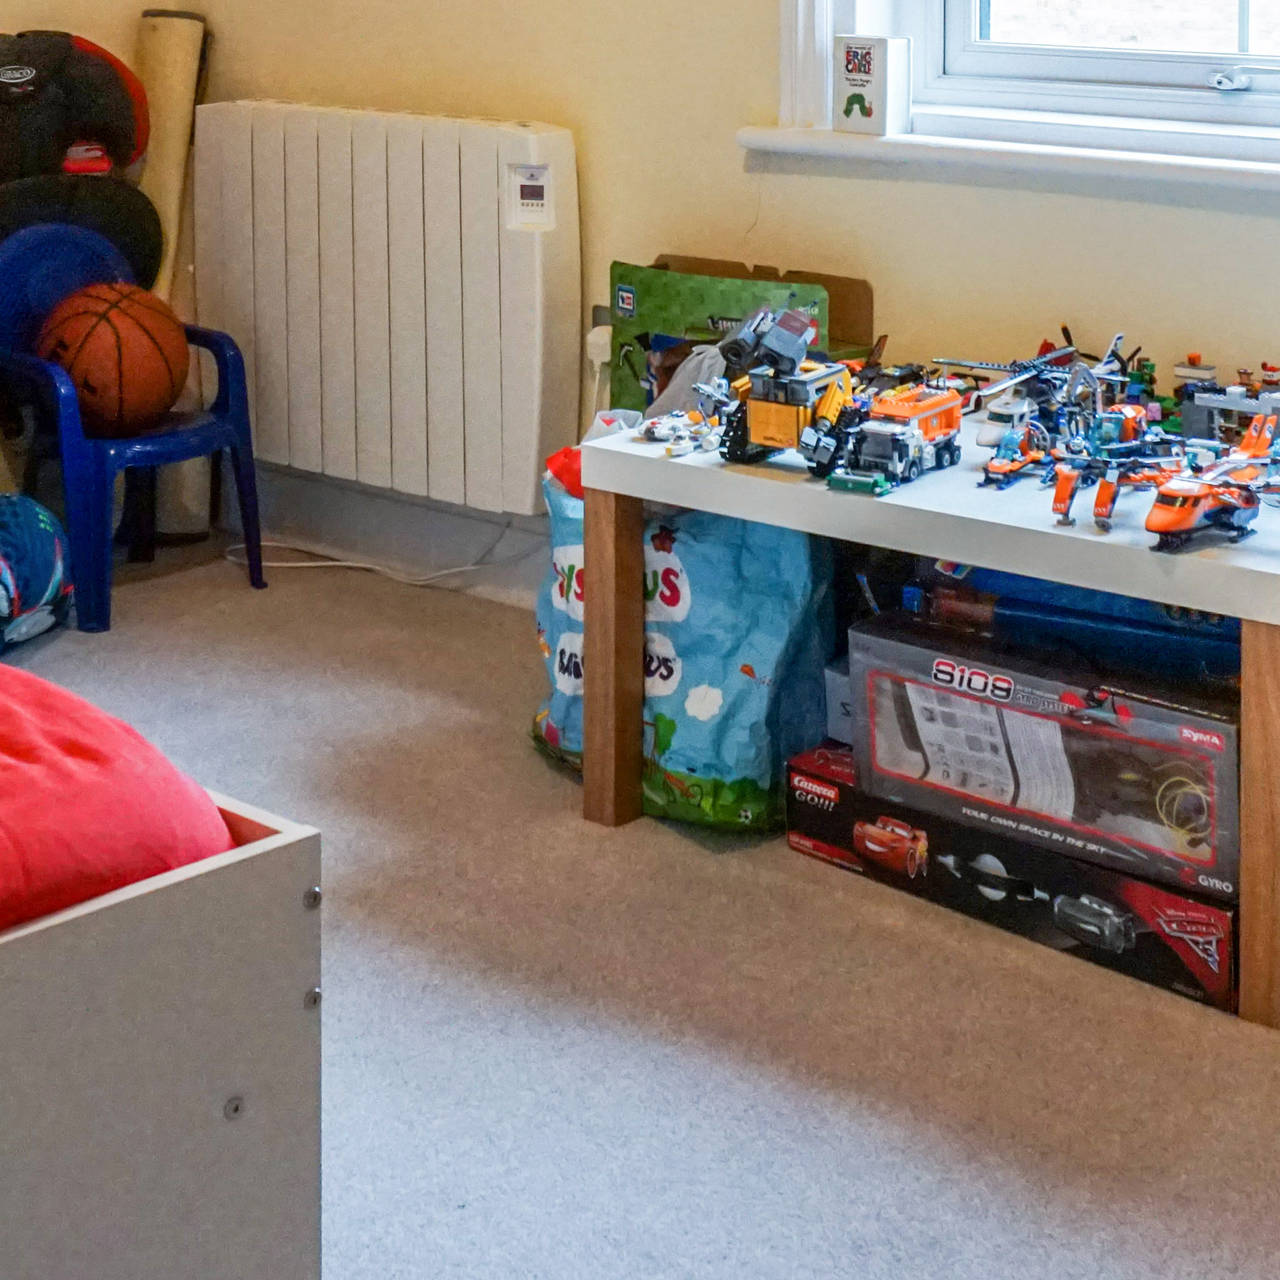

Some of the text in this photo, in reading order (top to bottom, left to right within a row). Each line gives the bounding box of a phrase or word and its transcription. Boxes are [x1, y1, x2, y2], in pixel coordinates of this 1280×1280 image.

[793, 775, 837, 799] Carrera
[795, 789, 835, 812] GO!!!
[962, 806, 1106, 854] YOUR OWN SPACE IN THE SKY
[1198, 874, 1233, 894] GYRO
